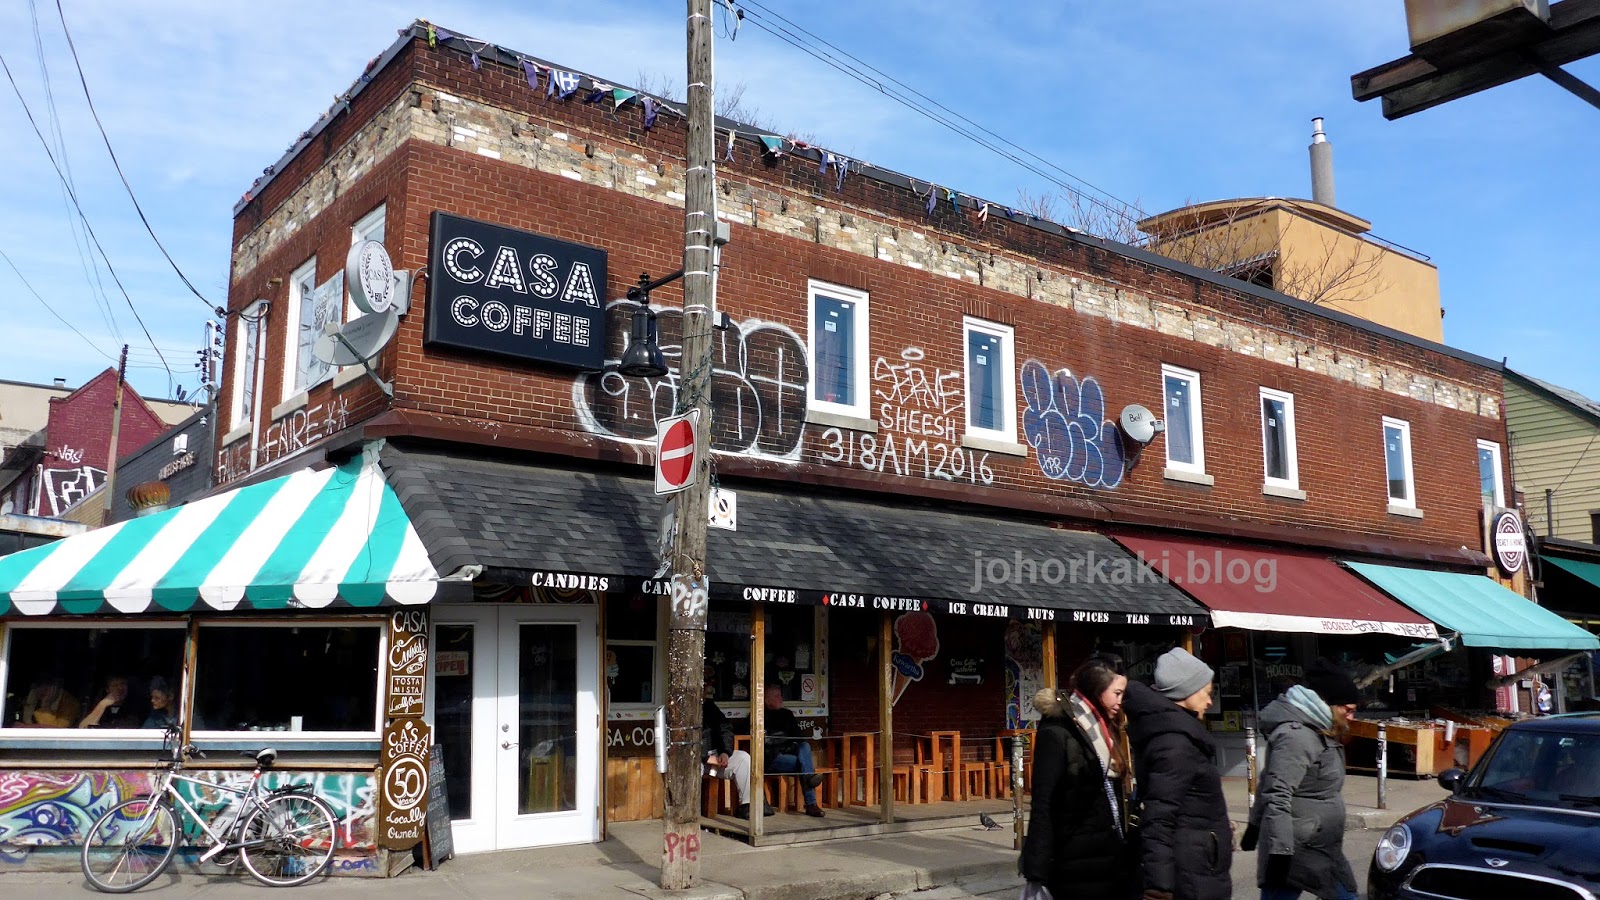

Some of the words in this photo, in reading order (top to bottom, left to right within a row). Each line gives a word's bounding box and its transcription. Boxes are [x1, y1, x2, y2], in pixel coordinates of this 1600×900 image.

[442, 236, 600, 308] CASA
[450, 295, 590, 348] COFFEE
[881, 402, 956, 444] SHEESH
[1129, 413, 1142, 422] Bell
[532, 572, 609, 591] CANDIES
[641, 580, 672, 596] CAN
[743, 587, 796, 603] COFFEE
[830, 593, 865, 609] CASA
[873, 596, 921, 612] COFFEE
[948, 602, 967, 616] ICE
[973, 604, 1009, 618] CREAM
[1027, 607, 1055, 621] NUTS
[1073, 610, 1110, 623] SPICES
[393, 611, 427, 632] CASA
[1126, 613, 1150, 625] TEAS
[1169, 615, 1194, 626] CASA
[1321, 620, 1353, 631] HOOKED
[1265, 665, 1304, 678] HOOKED
[395, 677, 420, 685] TOSTA
[388, 728, 429, 748] CASA
[631, 726, 655, 747] CO
[388, 742, 429, 760] COFFEE
[393, 767, 420, 798] 50
[386, 806, 427, 826] Locally
[387, 826, 419, 839] Owned
